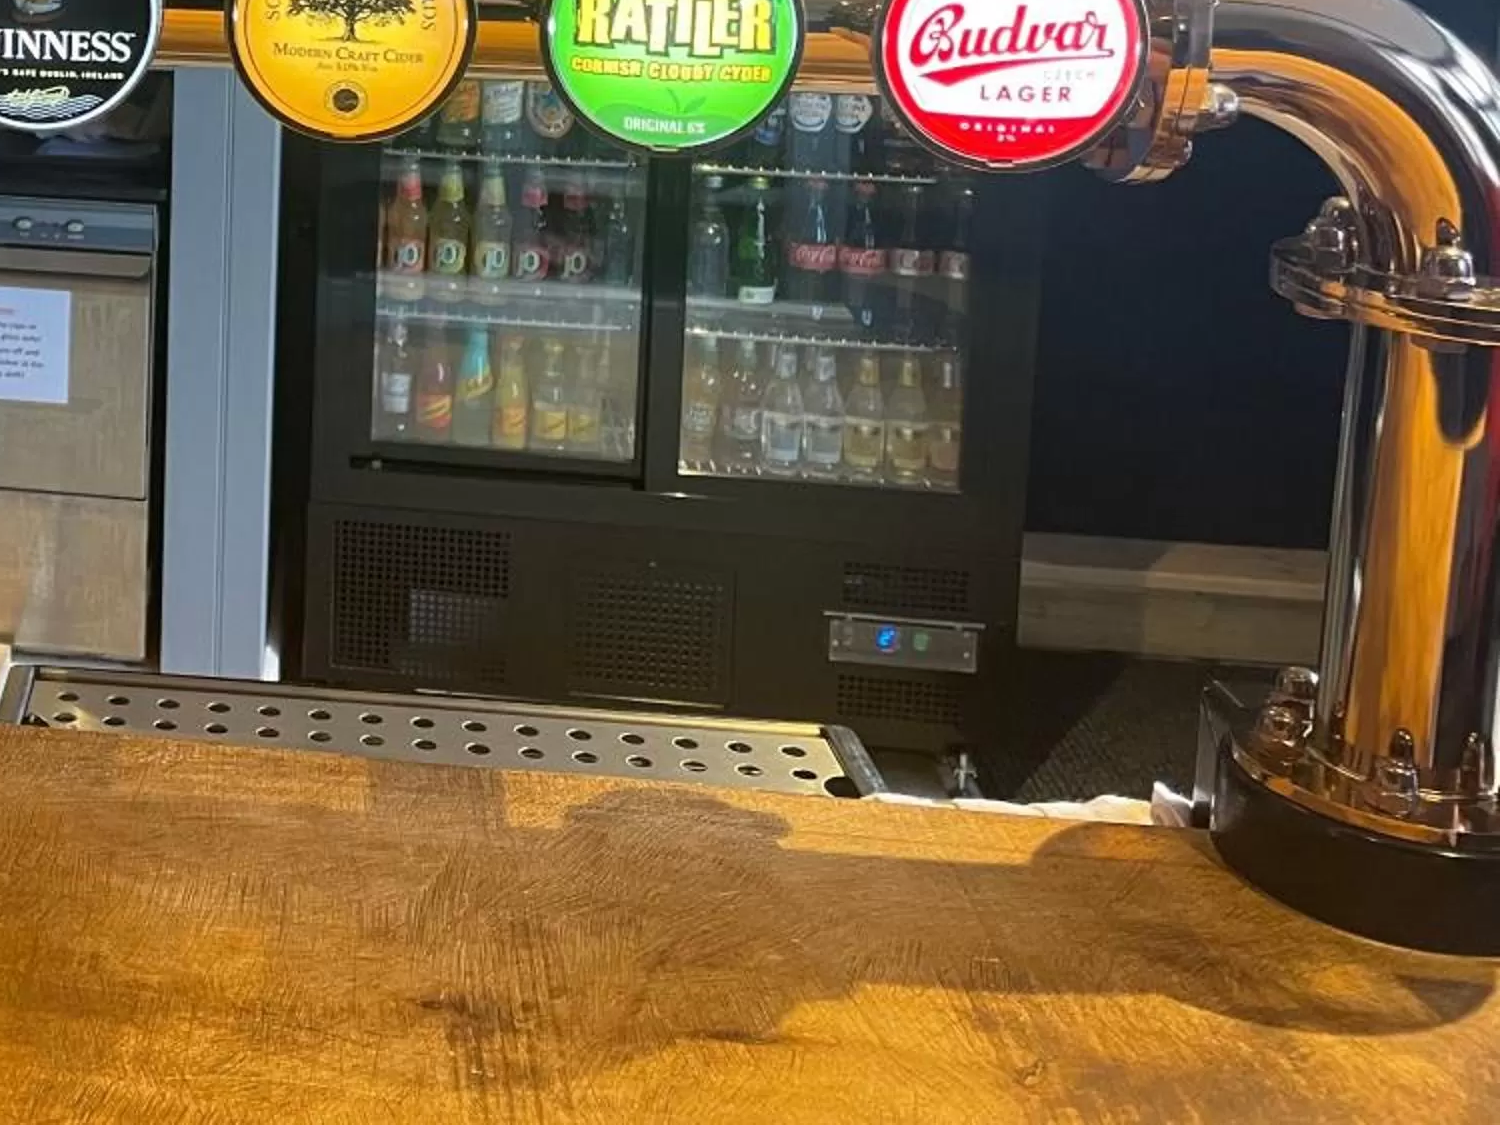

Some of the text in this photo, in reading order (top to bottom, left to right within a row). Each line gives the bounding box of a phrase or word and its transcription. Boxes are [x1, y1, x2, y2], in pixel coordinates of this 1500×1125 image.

[910, 3, 1115, 67] Budvar
[572, 56, 772, 83] CORNISH CLOUDY CYDER
[980, 85, 1072, 102] LAGER
[623, 116, 685, 134] ORIGINAL
